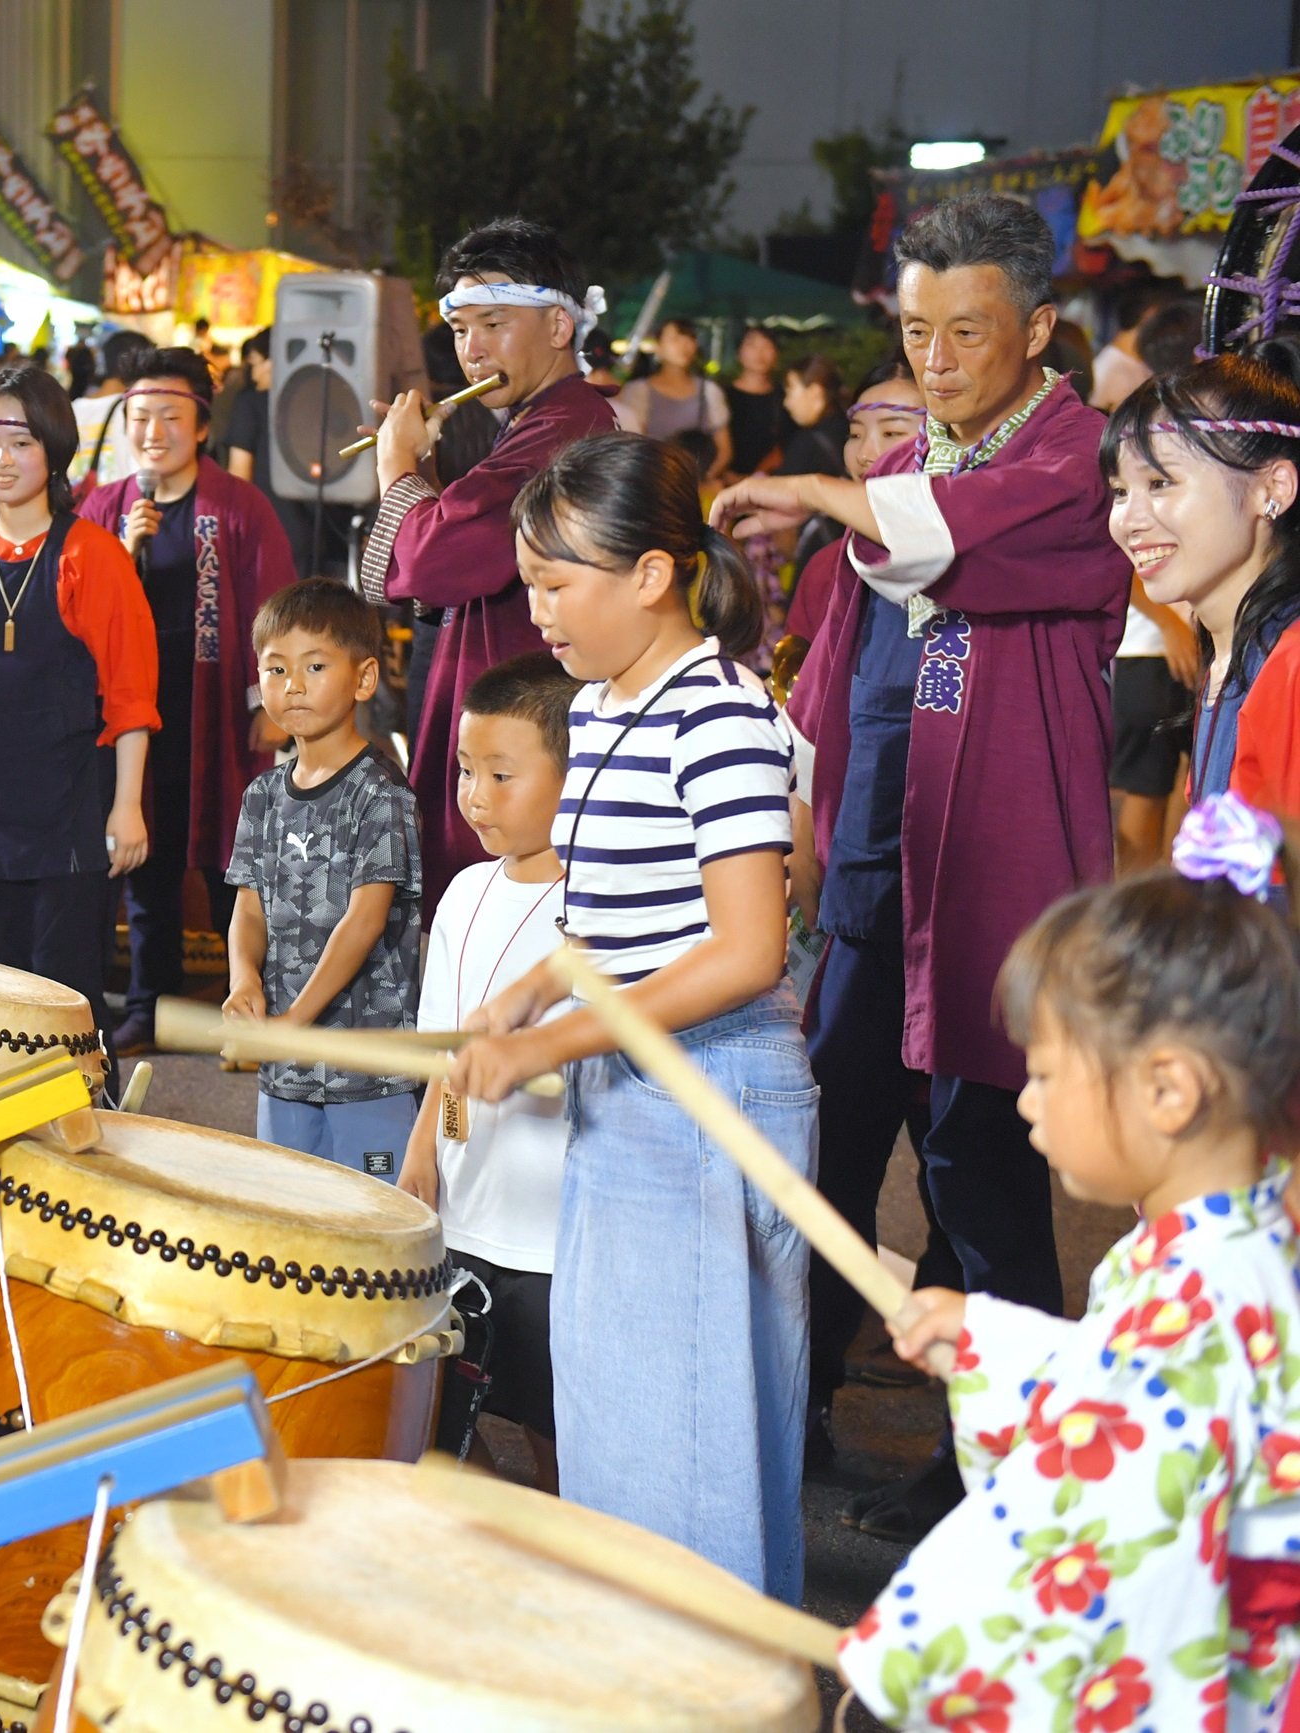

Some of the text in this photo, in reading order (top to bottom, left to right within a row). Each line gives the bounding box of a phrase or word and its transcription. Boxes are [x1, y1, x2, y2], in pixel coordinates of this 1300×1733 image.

[194, 515, 220, 662] やんさ太鼓
[915, 608, 971, 714] 太鼓
